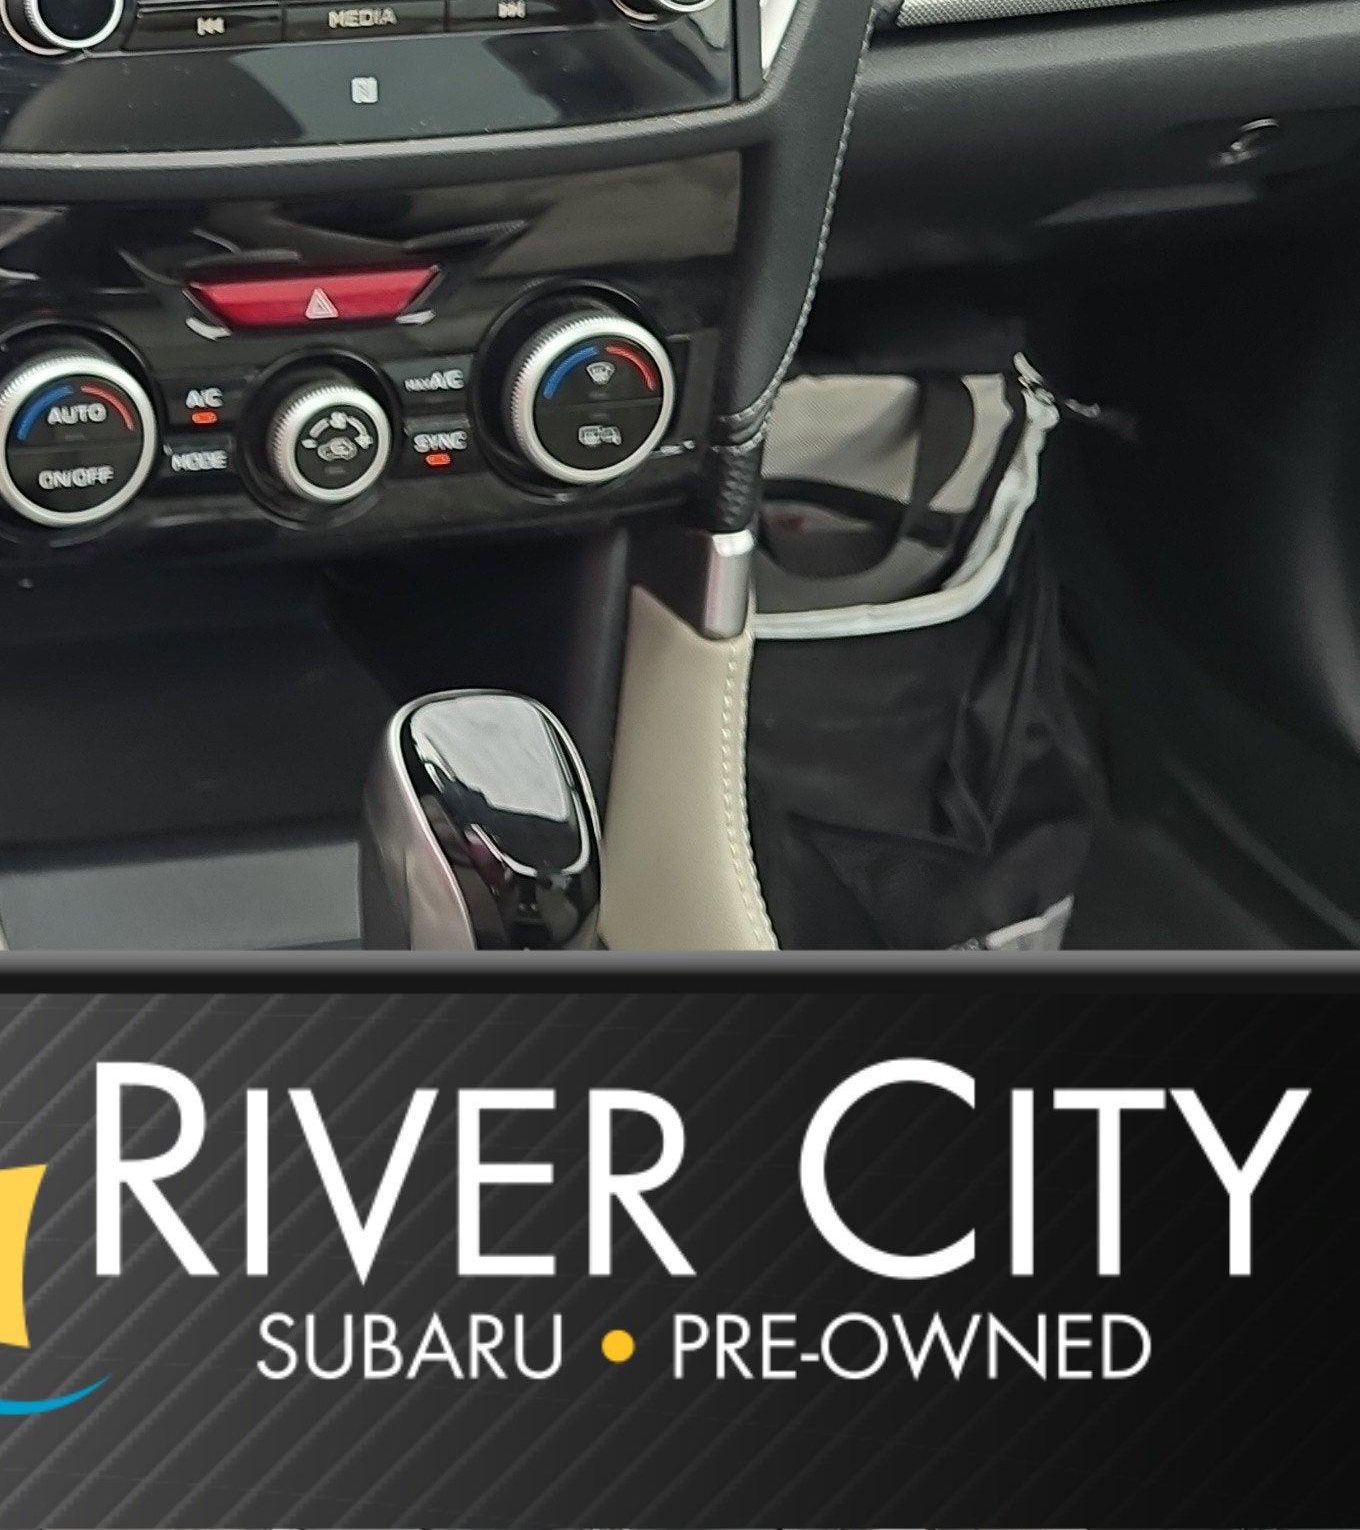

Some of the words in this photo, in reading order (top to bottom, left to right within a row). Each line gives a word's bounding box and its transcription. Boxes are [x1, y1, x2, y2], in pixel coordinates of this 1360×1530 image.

[328, 7, 398, 30] MEDIA
[185, 387, 224, 409] A/C
[47, 402, 107, 426] AUTO
[413, 430, 468, 454] SYNC
[171, 450, 229, 472] MODE
[38, 465, 115, 490] ON/OFF
